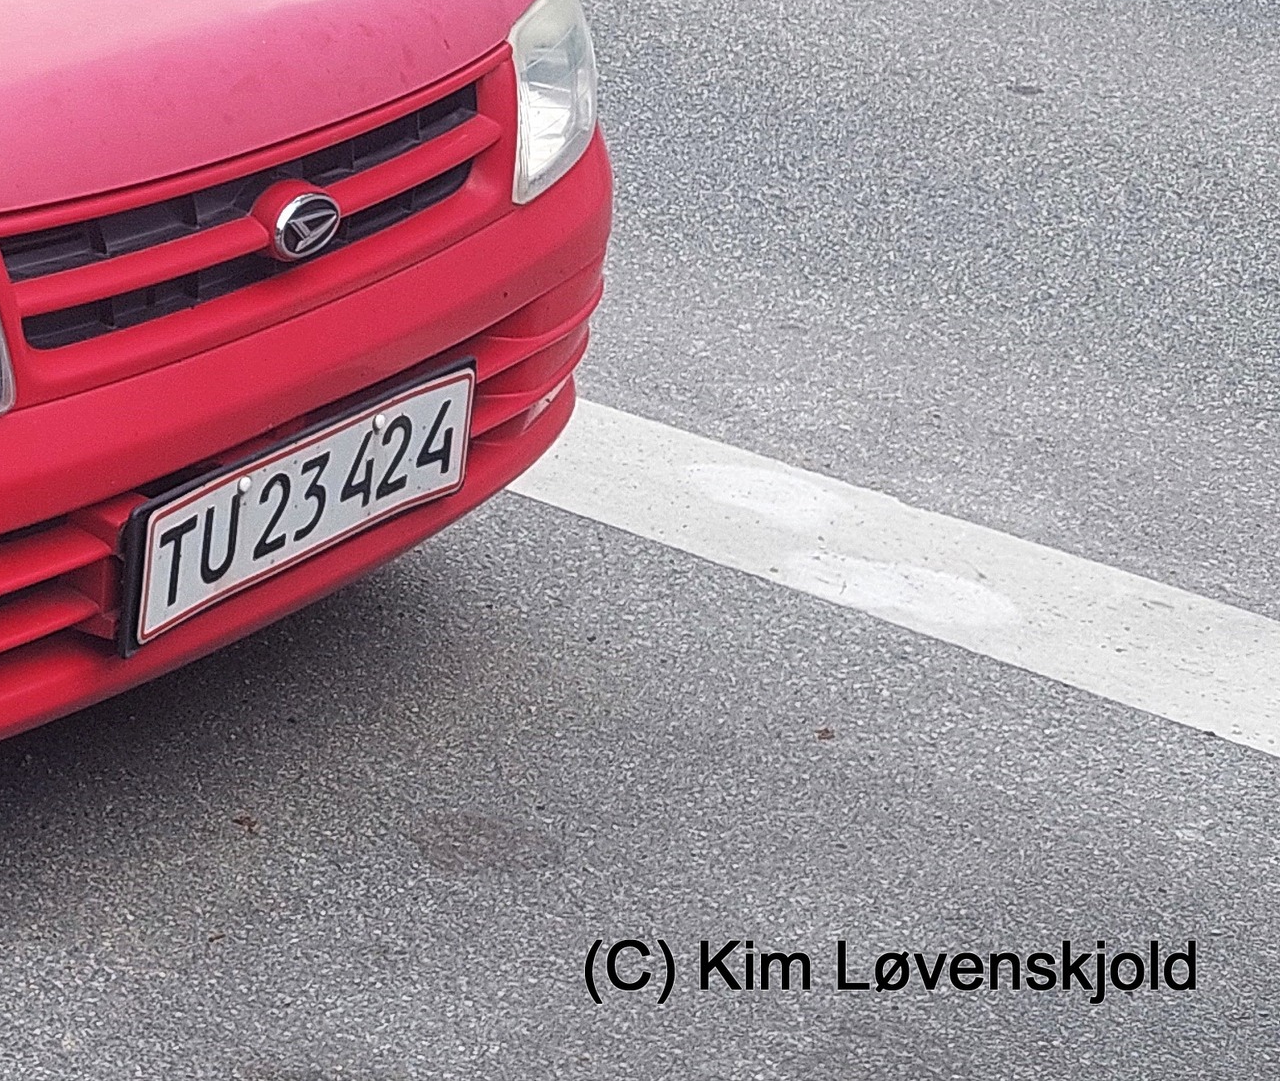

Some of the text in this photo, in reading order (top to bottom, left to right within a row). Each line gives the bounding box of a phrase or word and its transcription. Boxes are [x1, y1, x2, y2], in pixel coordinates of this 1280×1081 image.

[159, 399, 453, 607] TU 23 424
